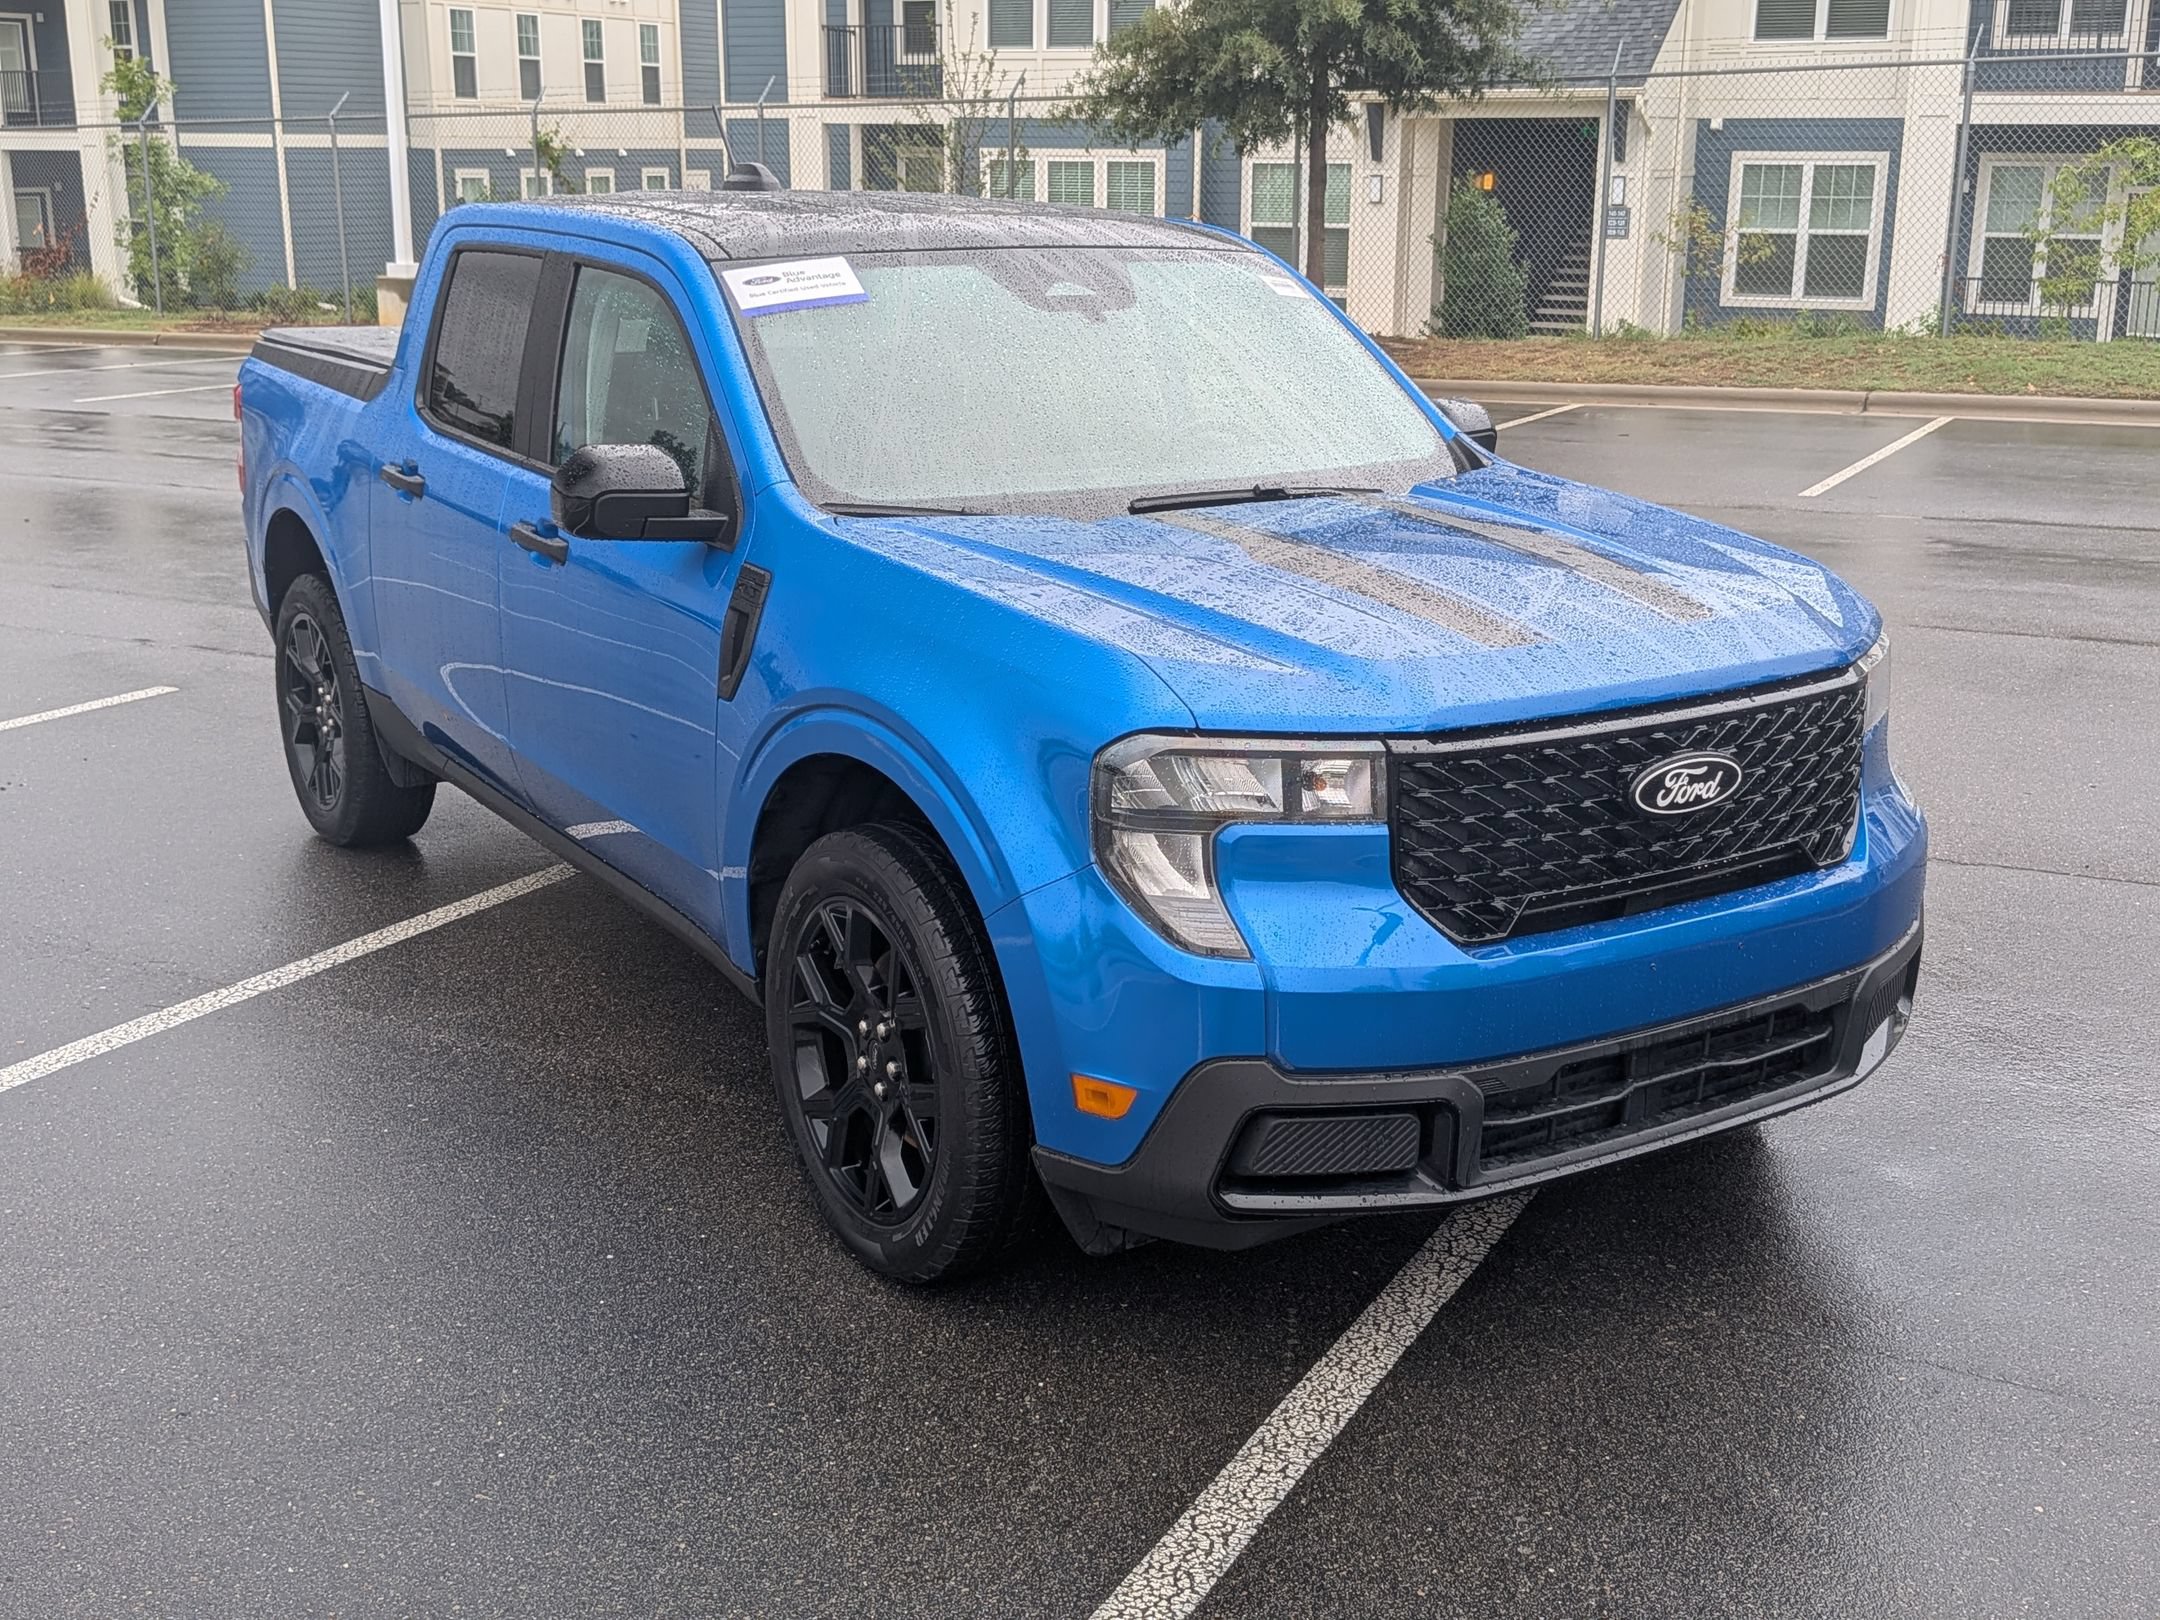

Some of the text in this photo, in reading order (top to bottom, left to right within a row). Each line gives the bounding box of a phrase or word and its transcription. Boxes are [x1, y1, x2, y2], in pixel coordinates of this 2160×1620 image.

[782, 270, 806, 278] Blue
[786, 271, 842, 284] Advantage
[767, 286, 799, 296] Certified
[1656, 765, 1724, 807] Ford
